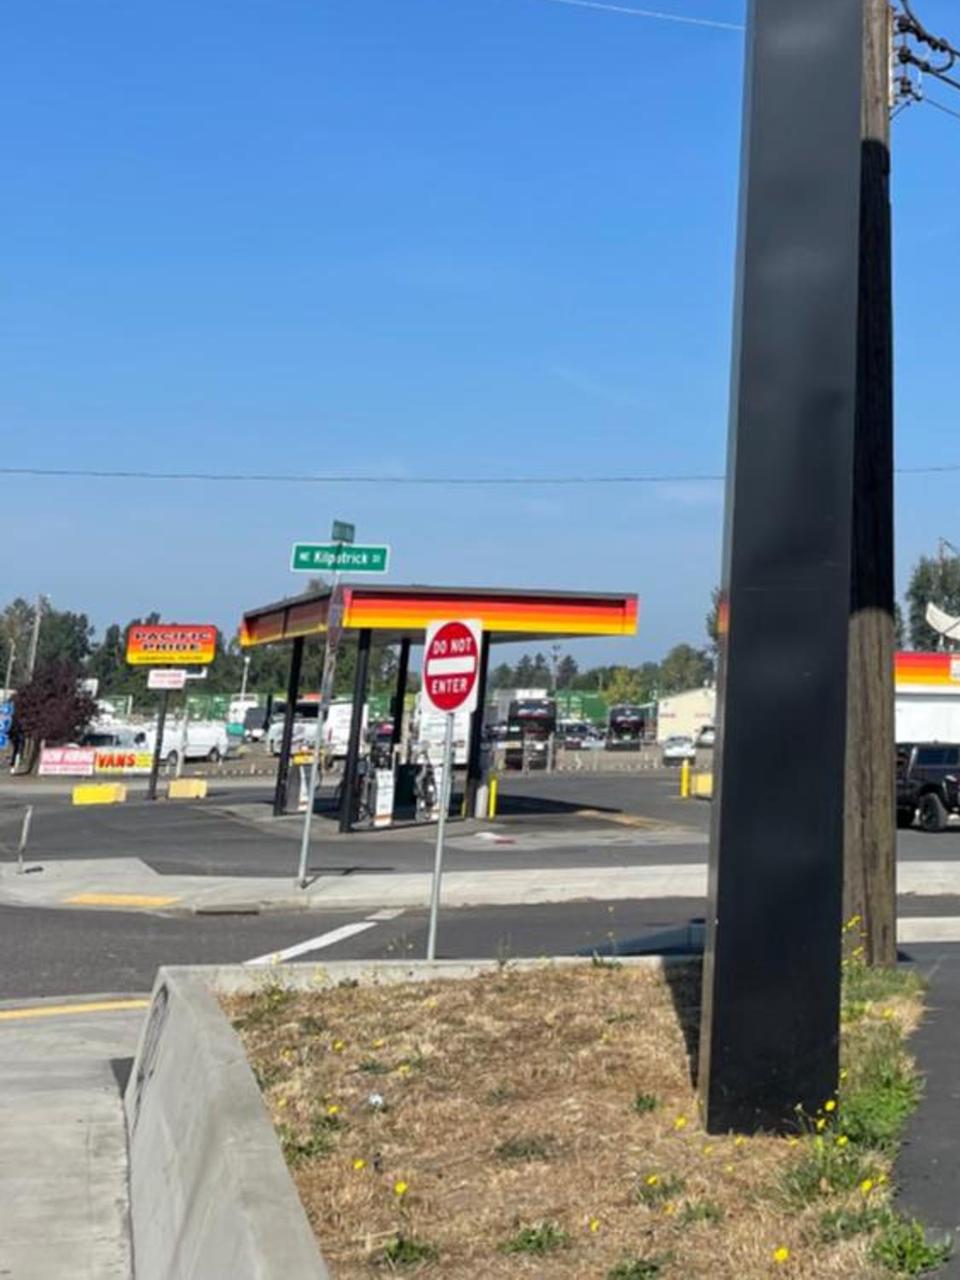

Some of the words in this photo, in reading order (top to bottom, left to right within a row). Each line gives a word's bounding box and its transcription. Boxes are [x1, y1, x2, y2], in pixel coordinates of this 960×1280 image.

[135, 631, 211, 640] PACIFIC
[143, 642, 202, 652] PRIDE
[433, 639, 448, 655] DO
[450, 636, 473, 653] NOT
[432, 678, 468, 695] ENTER
[98, 752, 136, 768] VANS
